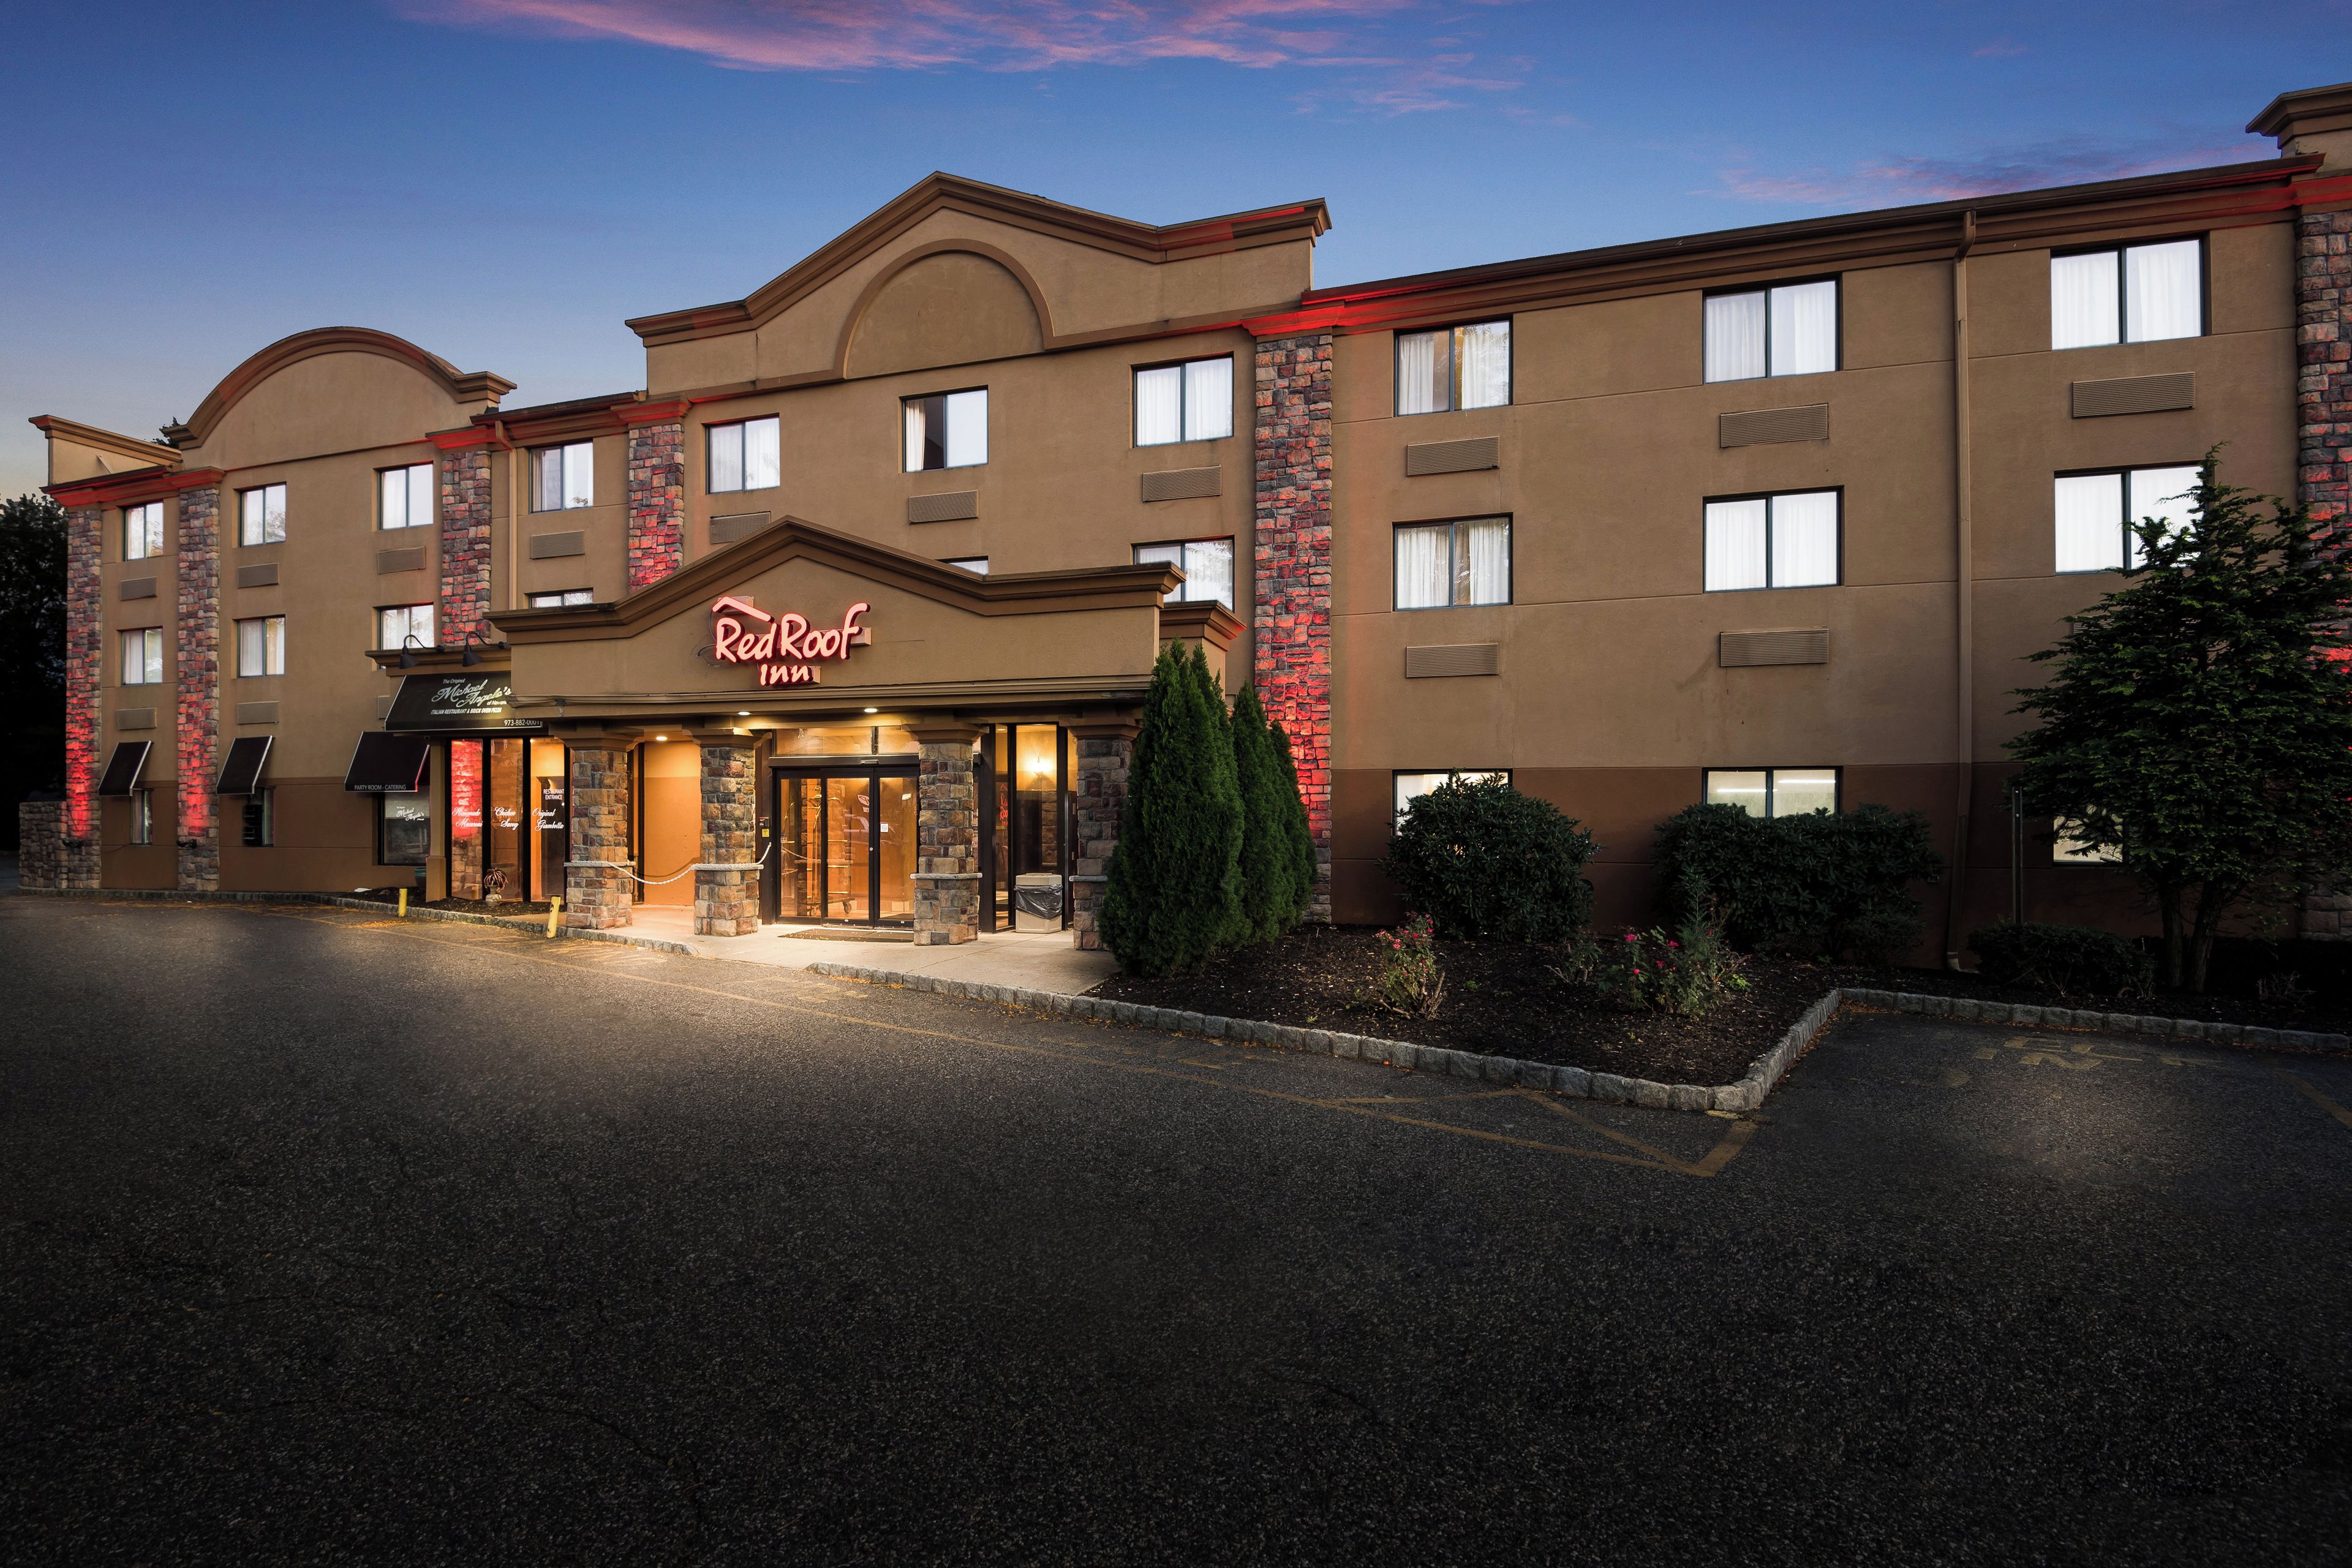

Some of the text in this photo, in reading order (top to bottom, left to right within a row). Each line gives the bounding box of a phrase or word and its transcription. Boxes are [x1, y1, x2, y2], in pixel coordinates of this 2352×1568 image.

[715, 602, 870, 663] Red Roof
[431, 679, 488, 703] Michael
[456, 687, 512, 708] Angelo's
[452, 807, 481, 816] Homemade
[494, 807, 516, 817] Chicken
[532, 807, 556, 820] Original
[455, 818, 483, 827] Macaroni
[500, 818, 519, 831] Savoy
